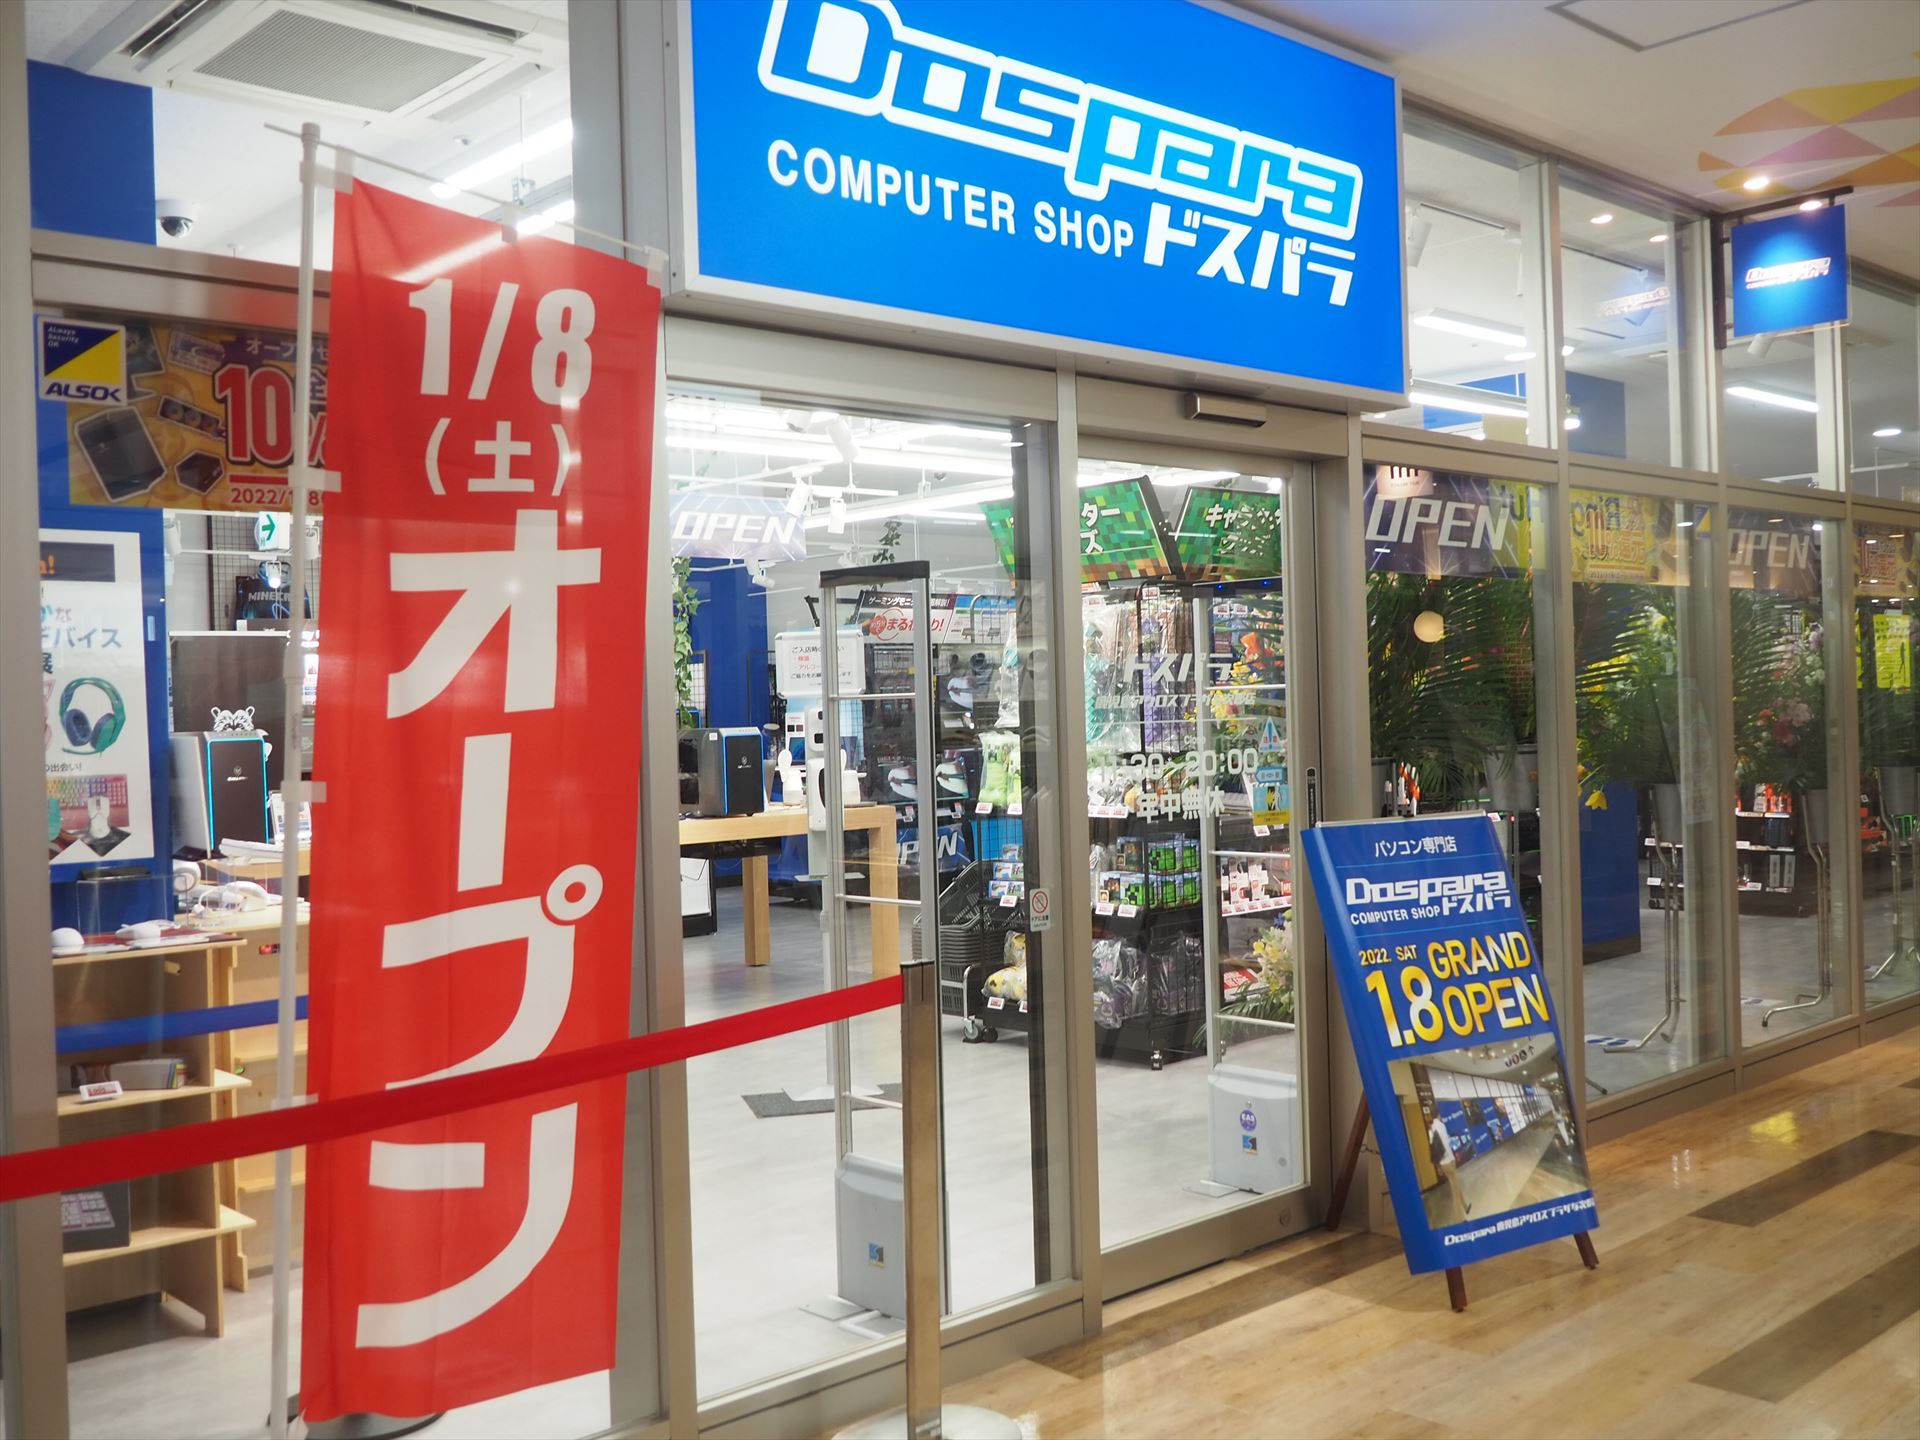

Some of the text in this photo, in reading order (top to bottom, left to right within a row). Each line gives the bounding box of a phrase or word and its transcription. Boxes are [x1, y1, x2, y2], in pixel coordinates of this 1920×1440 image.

[757, 0, 1363, 241] Dospara
[767, 139, 1356, 306] COMPUTER SHOP ドスパラ
[409, 278, 596, 408] 1/8
[46, 382, 121, 402] ALSOK
[425, 417, 571, 497] (土)
[672, 511, 797, 544] OPEN
[1366, 497, 1509, 550] OPEN
[1729, 528, 1810, 570] OPEN
[1136, 786, 1226, 824] 年中無休
[1375, 835, 1458, 857] パソコン専門店
[1346, 871, 1507, 906] Dospara
[1351, 889, 1512, 925] COMPUTER SHOP ドスパラ
[356, 508, 602, 1350] オープン
[1396, 944, 1417, 961] SAT
[1427, 931, 1532, 980] GRAND
[1365, 965, 1445, 1048] 1.8
[1442, 973, 1551, 1036] OPEN
[1444, 1225, 1496, 1246] Dospara
